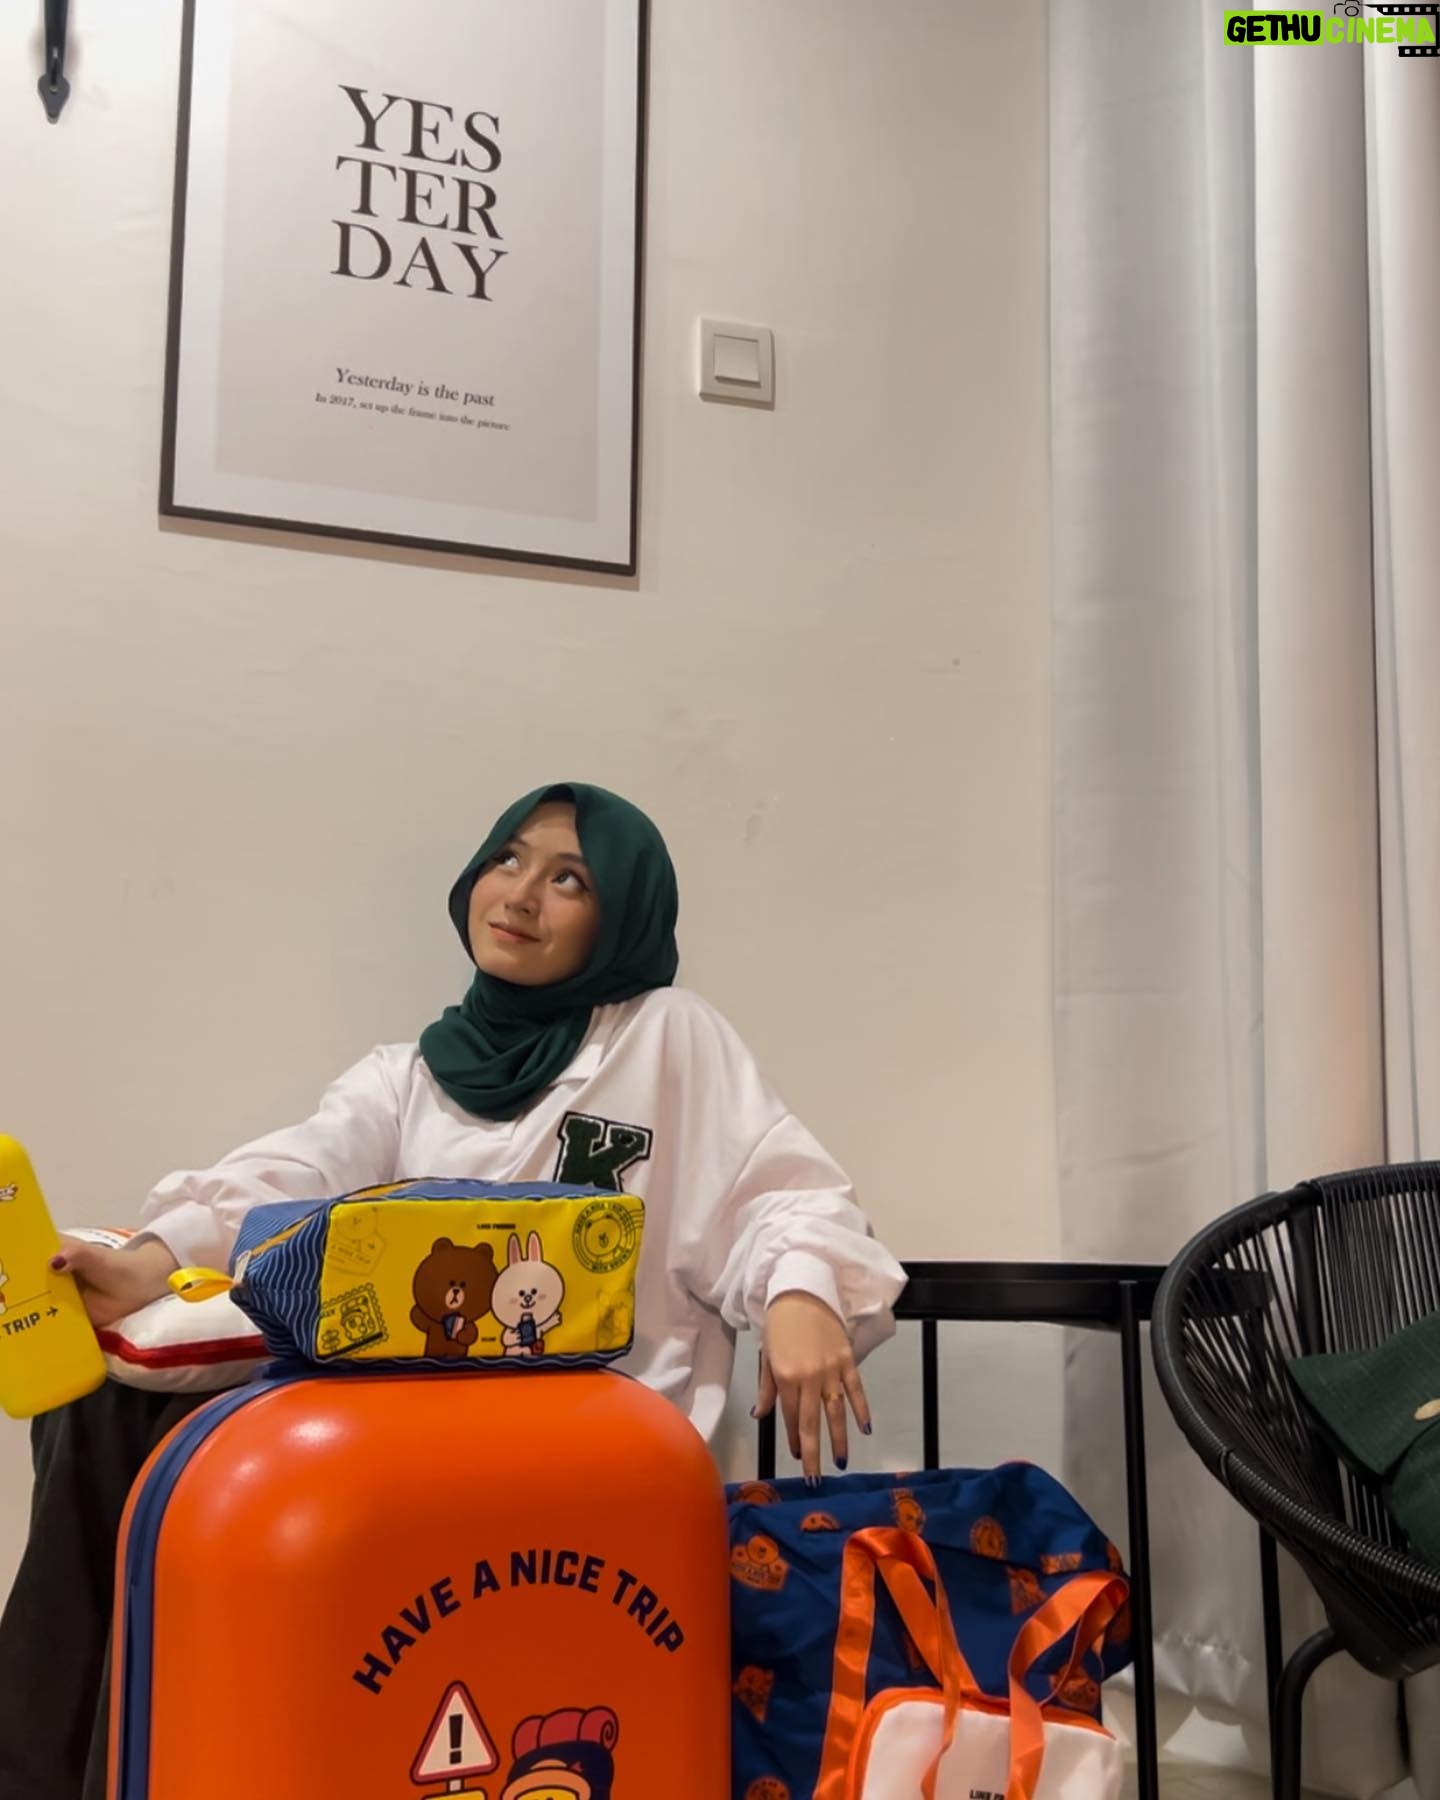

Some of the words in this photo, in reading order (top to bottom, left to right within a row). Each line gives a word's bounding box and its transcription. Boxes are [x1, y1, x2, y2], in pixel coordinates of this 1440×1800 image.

[338, 84, 502, 173] YES
[335, 155, 504, 241] TER
[330, 219, 509, 302] DAY
[315, 392, 327, 403] In
[374, 403, 390, 414] up
[390, 404, 406, 415] the
[408, 407, 435, 419] frame
[460, 416, 475, 425] the
[477, 420, 512, 431] picture
[336, 367, 414, 396] Yesterday
[416, 381, 430, 396] is
[434, 384, 459, 401] the
[463, 391, 496, 407] past
[2, 1312, 40, 1336] TRIP
[352, 1576, 462, 1696] HAVE
[473, 1559, 501, 1600] A
[510, 1549, 606, 1594] NICE
[611, 1568, 685, 1653] TRIP
